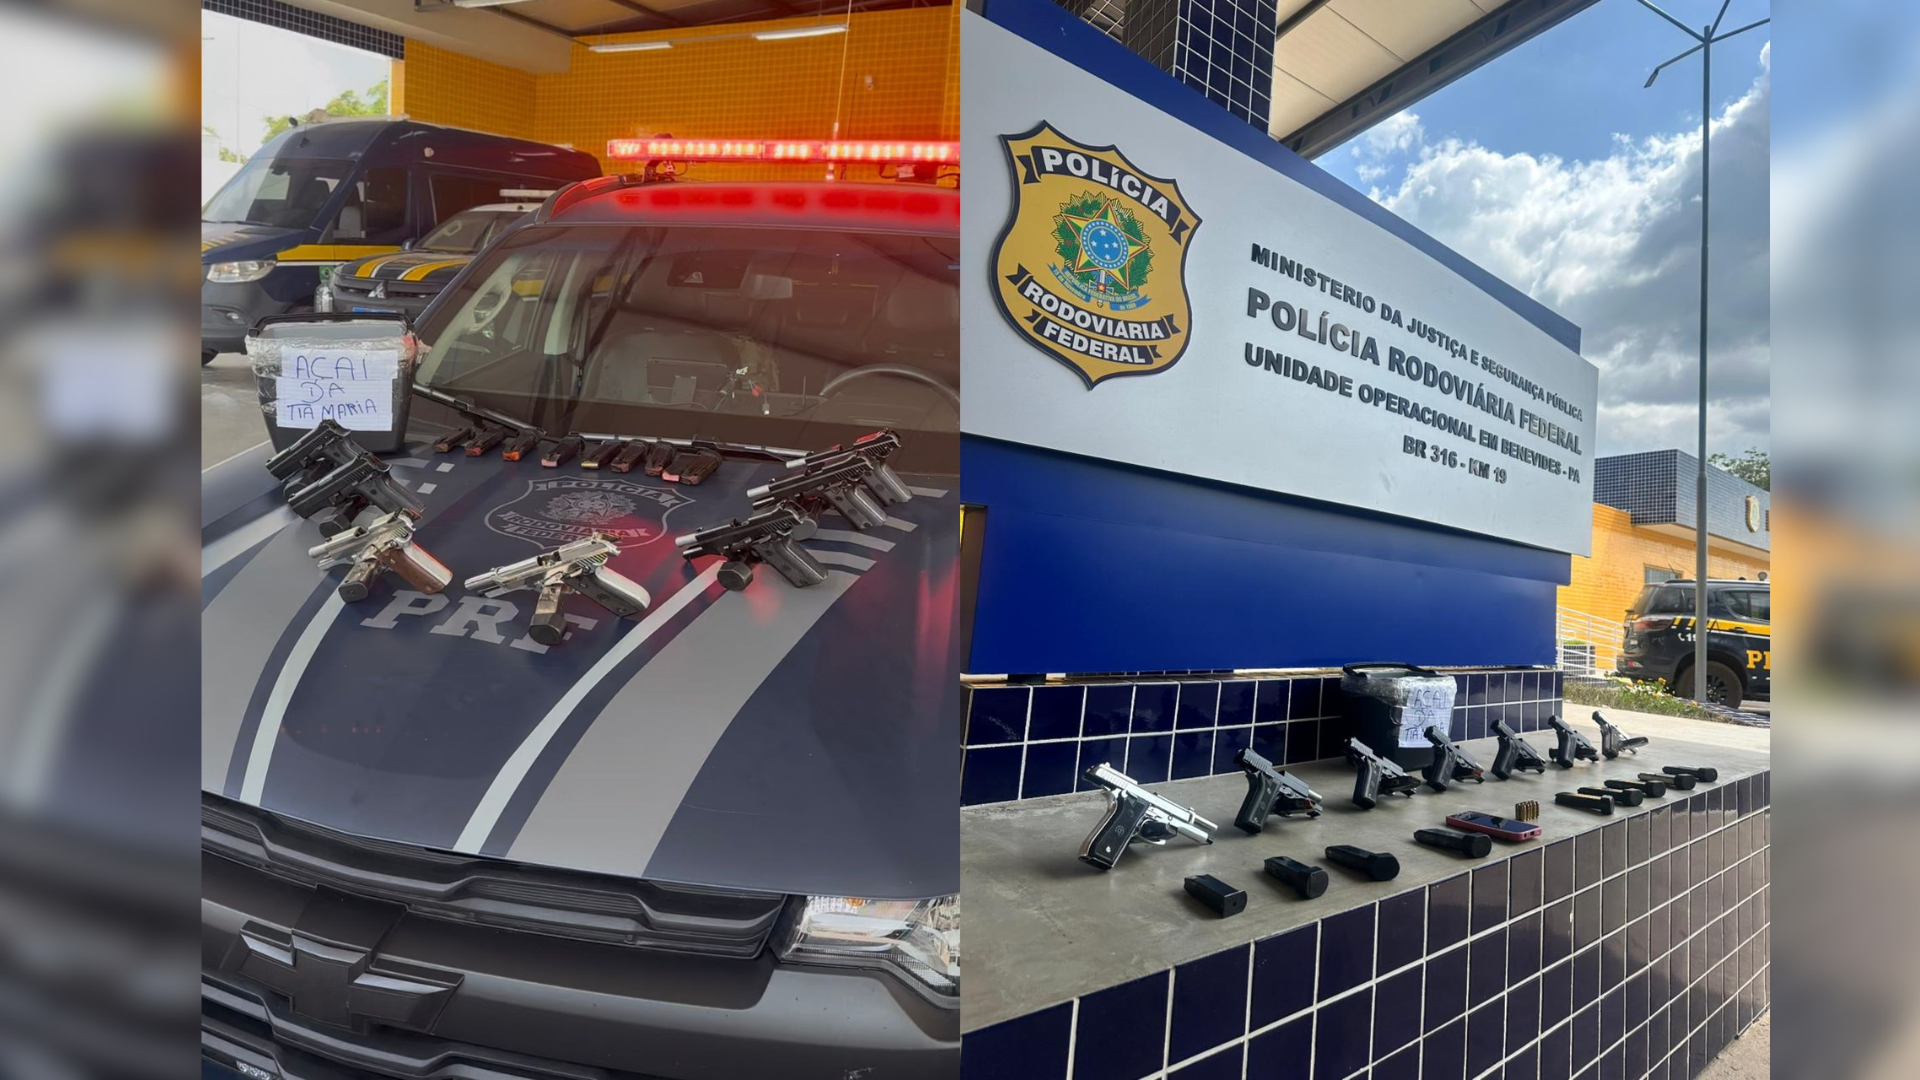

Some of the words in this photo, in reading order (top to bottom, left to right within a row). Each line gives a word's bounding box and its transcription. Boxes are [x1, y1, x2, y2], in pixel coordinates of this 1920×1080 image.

[1041, 148, 1168, 220] POLÍCIA
[1023, 280, 1165, 339] RODOVIÁRIA
[1042, 320, 1146, 363] FEDERAL
[1251, 243, 1375, 313] MINISTERIO
[1380, 303, 1403, 328] DA
[1407, 317, 1467, 360] JUSTIÇA
[1470, 349, 1479, 365] E
[1481, 355, 1545, 401] SEGURANÇA
[1546, 391, 1583, 422] PÚBLICA
[1247, 287, 1380, 366] POLÍCIA
[1388, 345, 1515, 425] RODOVIÁRIA
[1519, 408, 1582, 456] FEDERAL
[286, 403, 315, 420] TIA
[1244, 342, 1353, 398] UNIDADE
[1358, 383, 1476, 443] OPERACIONAL
[1479, 429, 1499, 451] EM
[1501, 438, 1562, 476] BENEVIDES
[1568, 466, 1581, 484] PA
[1403, 434, 1427, 459] BR
[1430, 444, 1458, 469] 316
[1469, 457, 1490, 479] KM
[1493, 466, 1507, 484] 19
